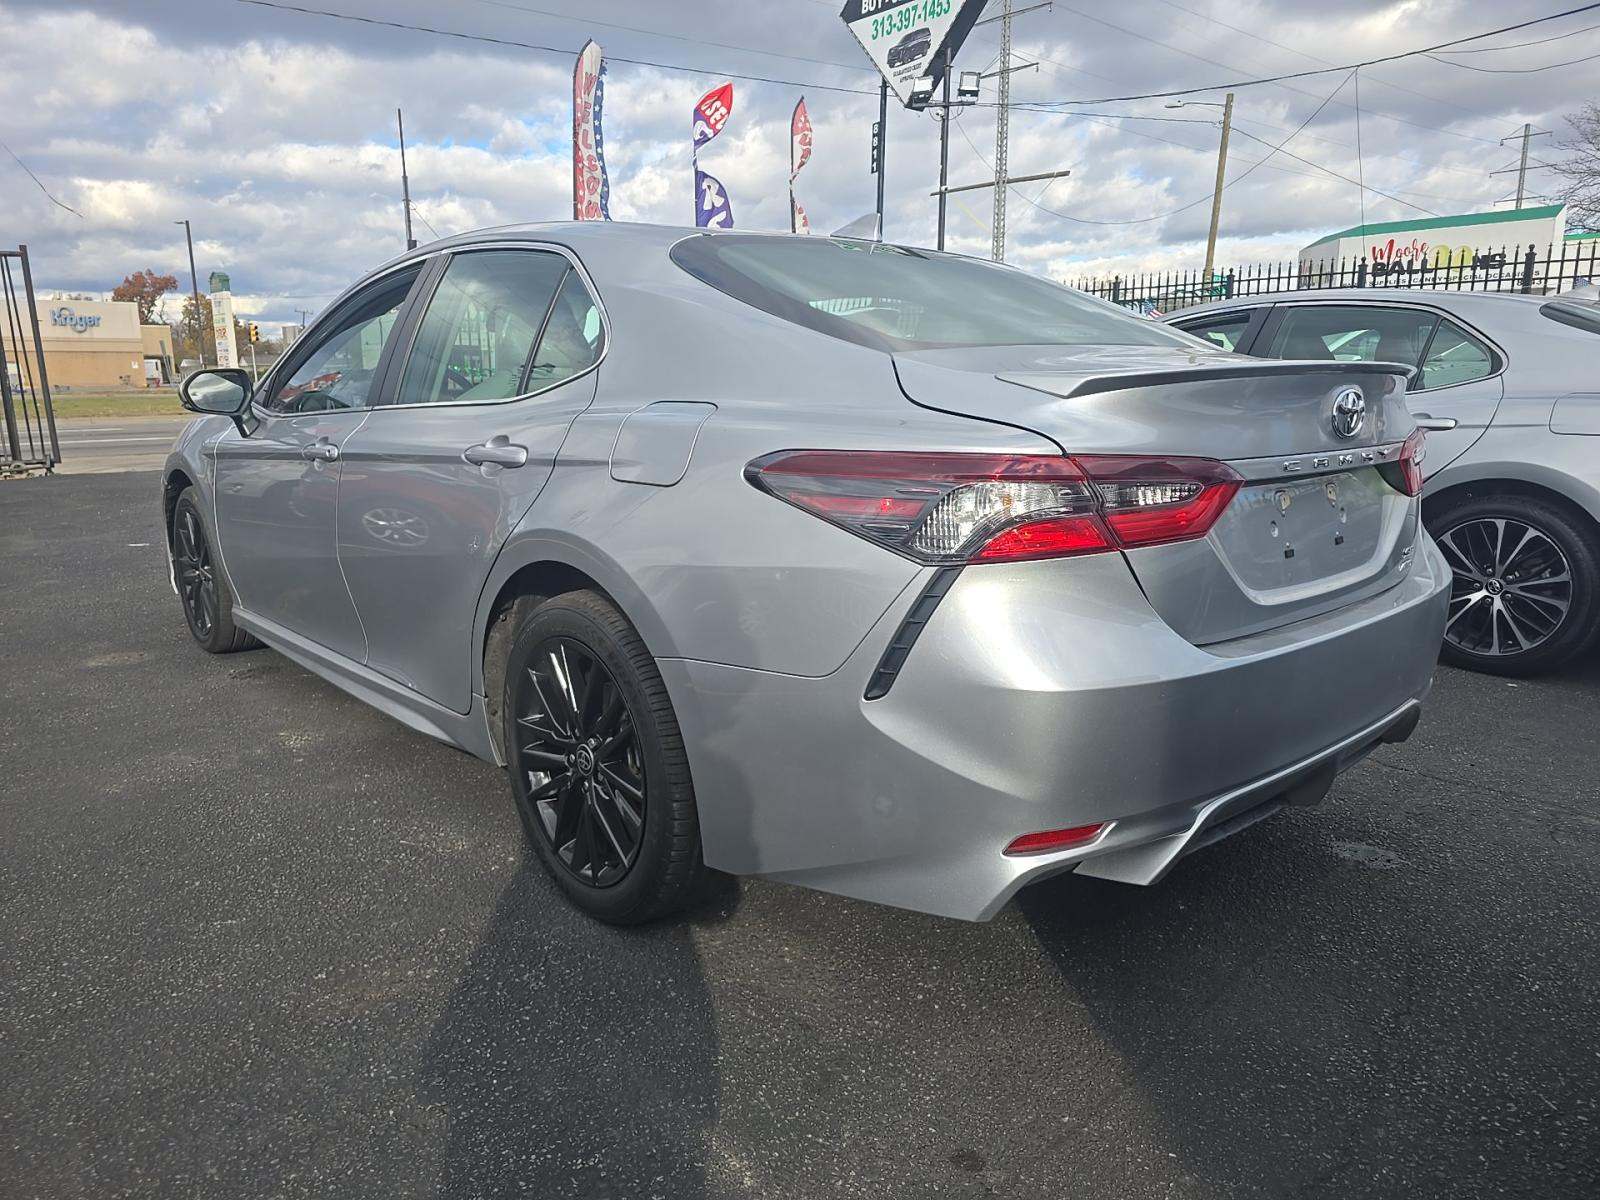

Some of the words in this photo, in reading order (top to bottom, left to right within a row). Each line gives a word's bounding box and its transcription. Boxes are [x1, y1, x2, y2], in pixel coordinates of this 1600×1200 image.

[871, 0, 951, 40] 313-397-1453
[1371, 238, 1430, 262] Moore
[51, 307, 102, 333] Kroger
